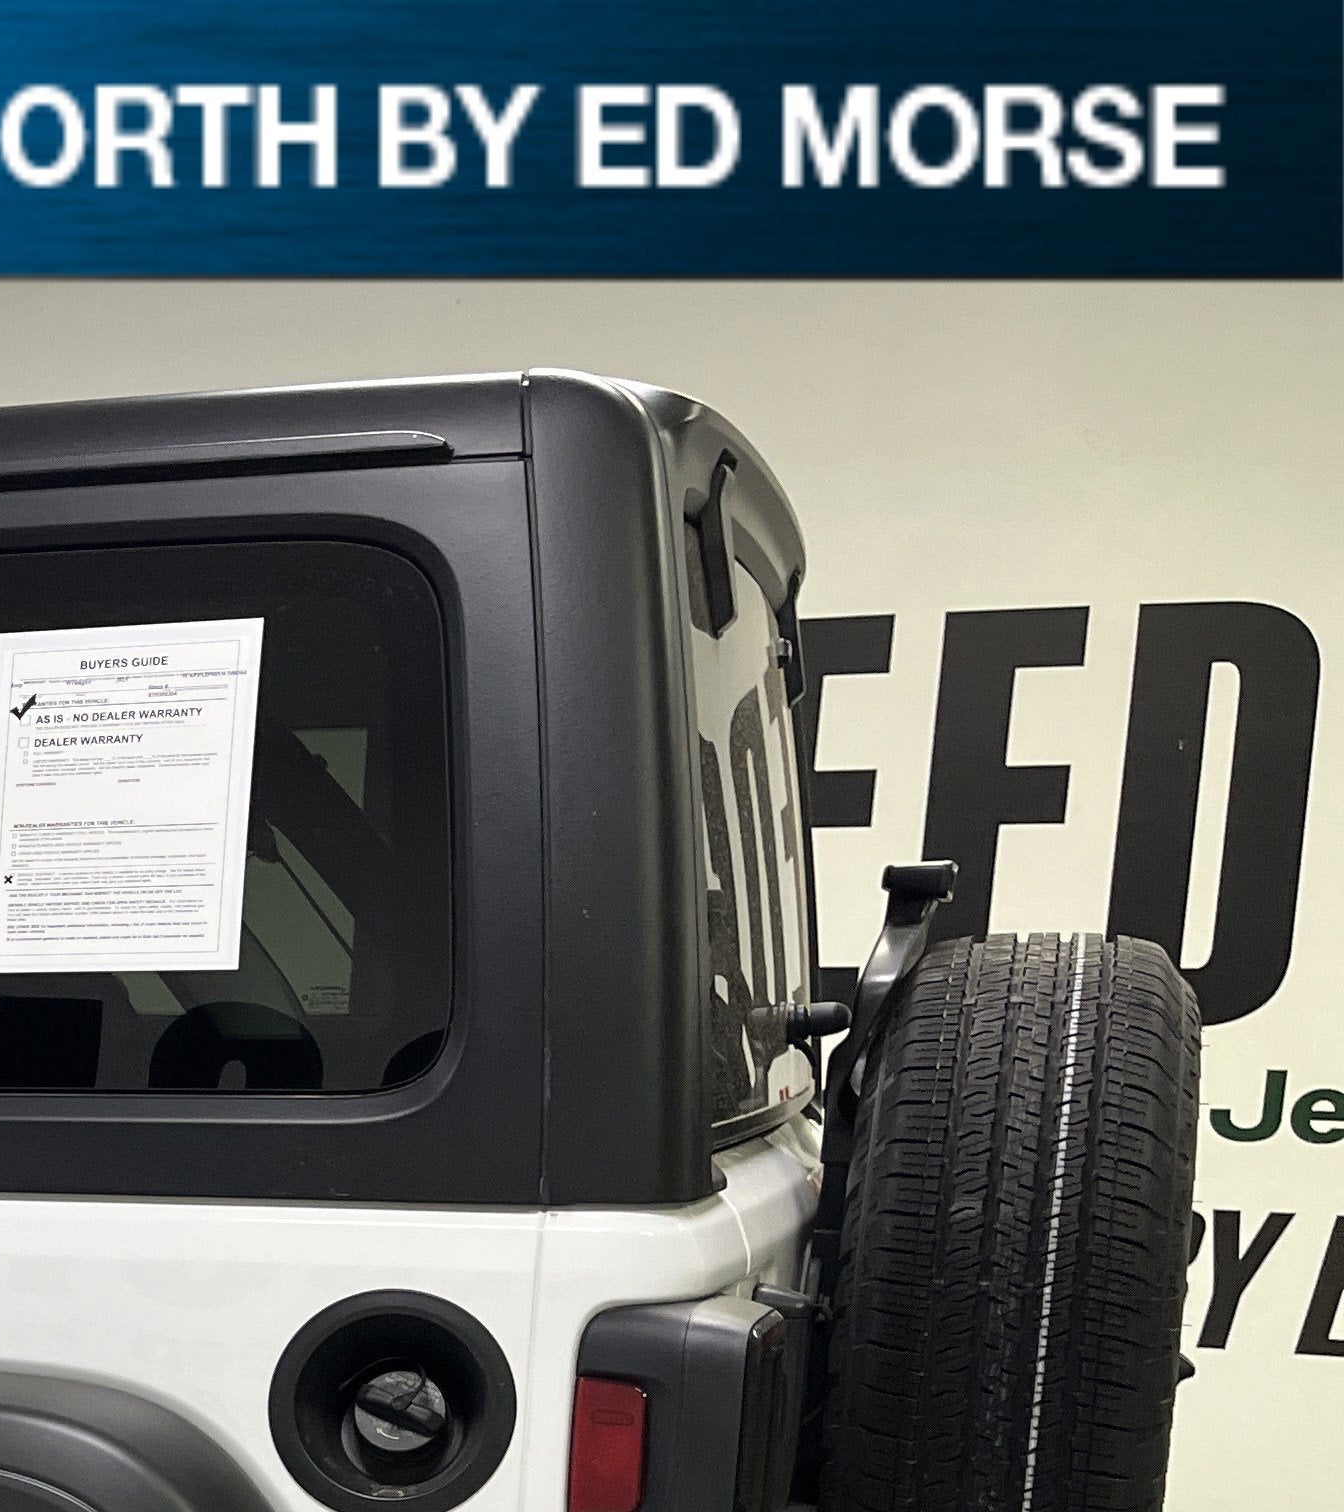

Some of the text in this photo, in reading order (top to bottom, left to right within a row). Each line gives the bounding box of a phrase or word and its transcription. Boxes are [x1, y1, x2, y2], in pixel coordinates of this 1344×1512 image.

[80, 655, 169, 671] BUYERS GUIDE
[36, 714, 51, 725] AS
[53, 714, 64, 724] IS
[73, 712, 89, 723] NO
[91, 710, 137, 722] DEALER
[139, 707, 203, 719] WARRANTY
[34, 733, 144, 748] DEALER WARRANTY
